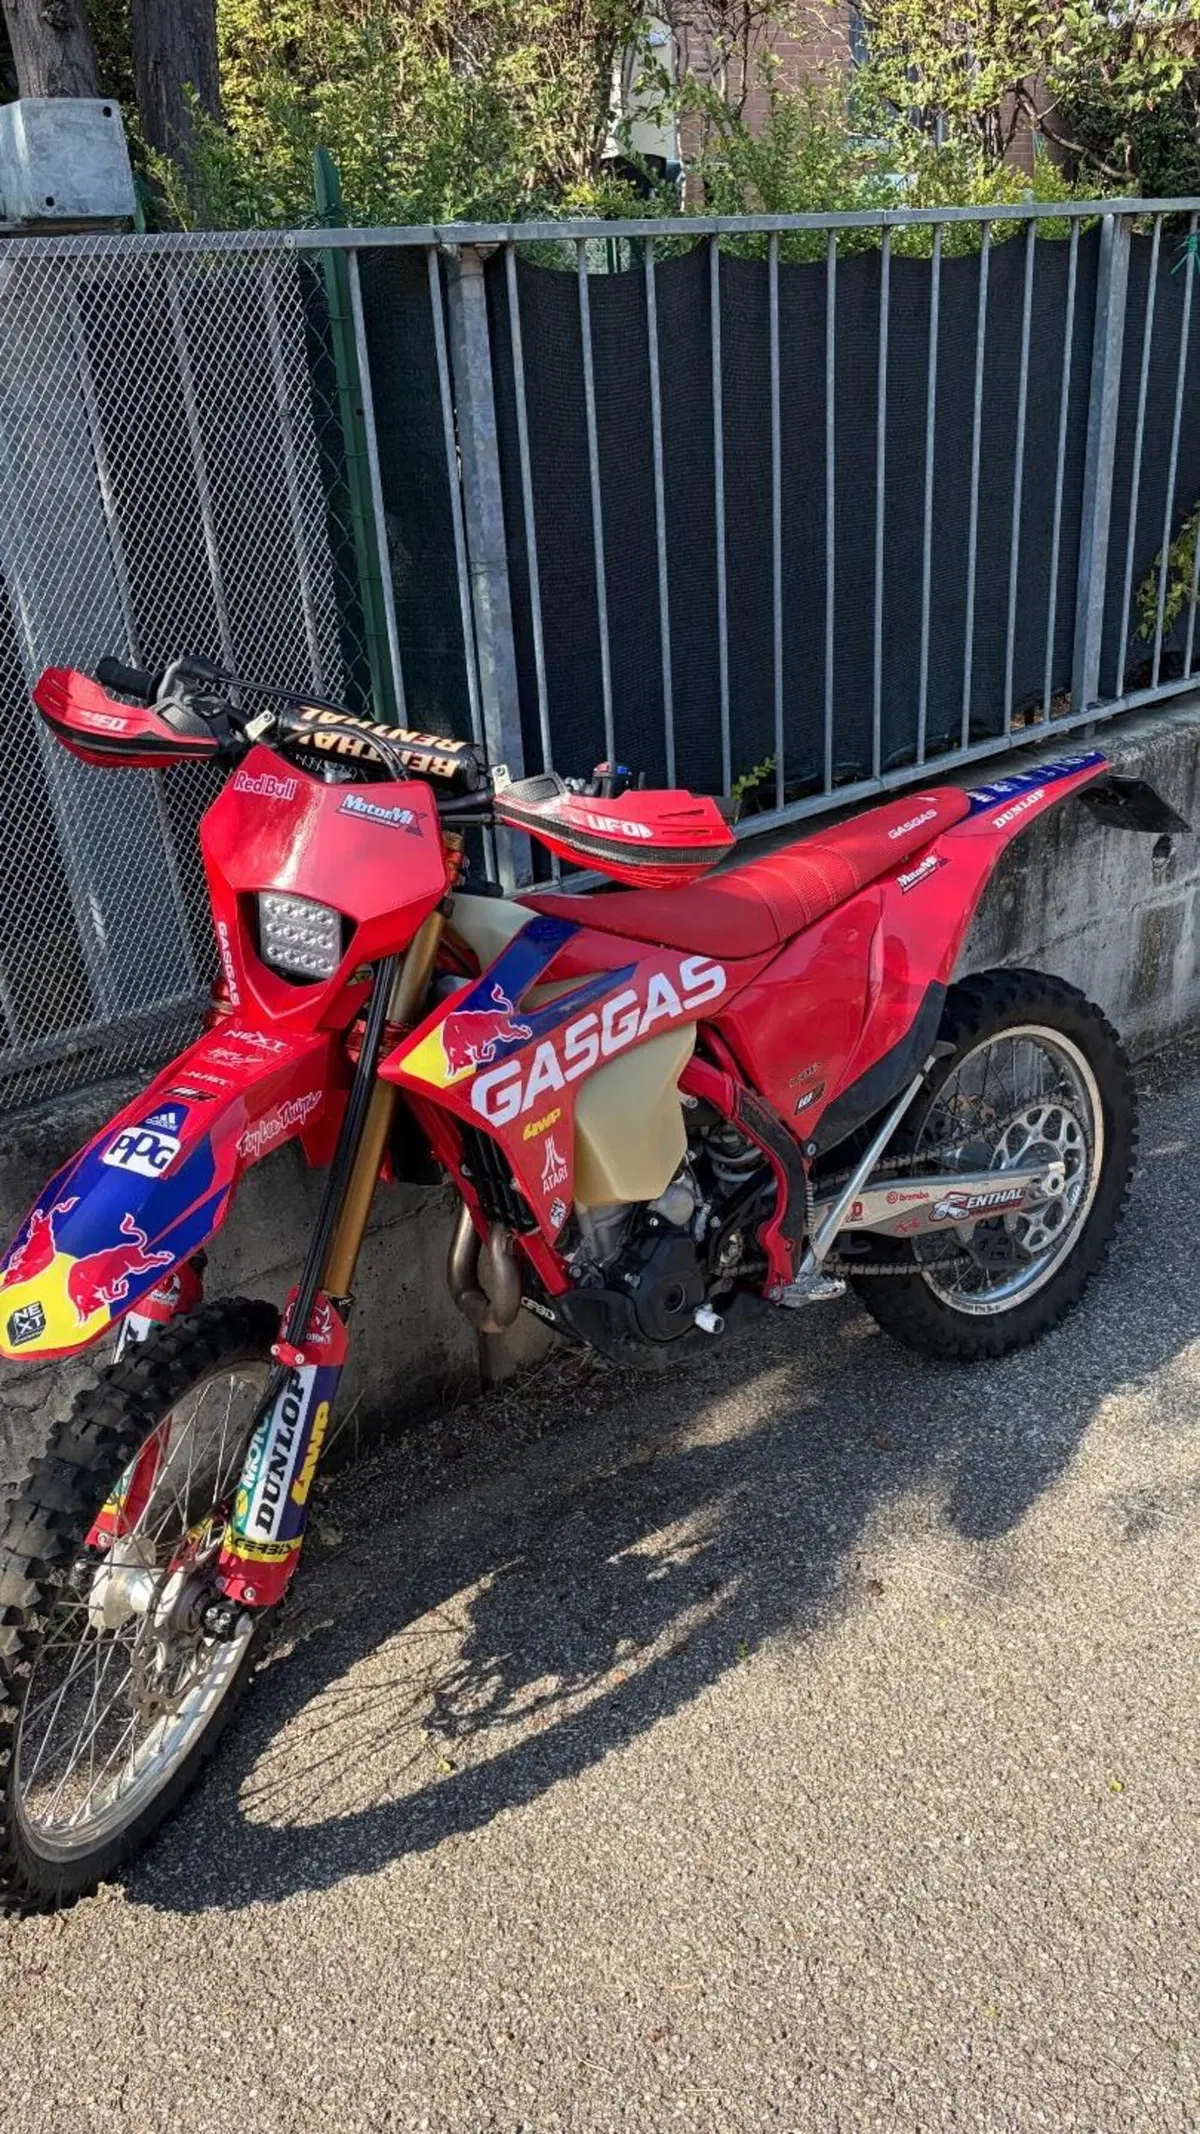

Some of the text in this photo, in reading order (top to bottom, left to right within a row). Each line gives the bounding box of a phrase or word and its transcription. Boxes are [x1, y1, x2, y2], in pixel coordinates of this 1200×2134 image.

[300, 706, 467, 752] RENTHAL
[234, 770, 297, 800] Red Bull
[888, 808, 938, 840] GASGAS
[993, 789, 1045, 828] DUNLOP
[217, 921, 240, 1007] GASGAS
[471, 956, 727, 1128] GASGAS
[108, 1132, 175, 1169] PPG
[542, 1165, 569, 1195] ATARI
[255, 1371, 305, 1536] DUNLOP
